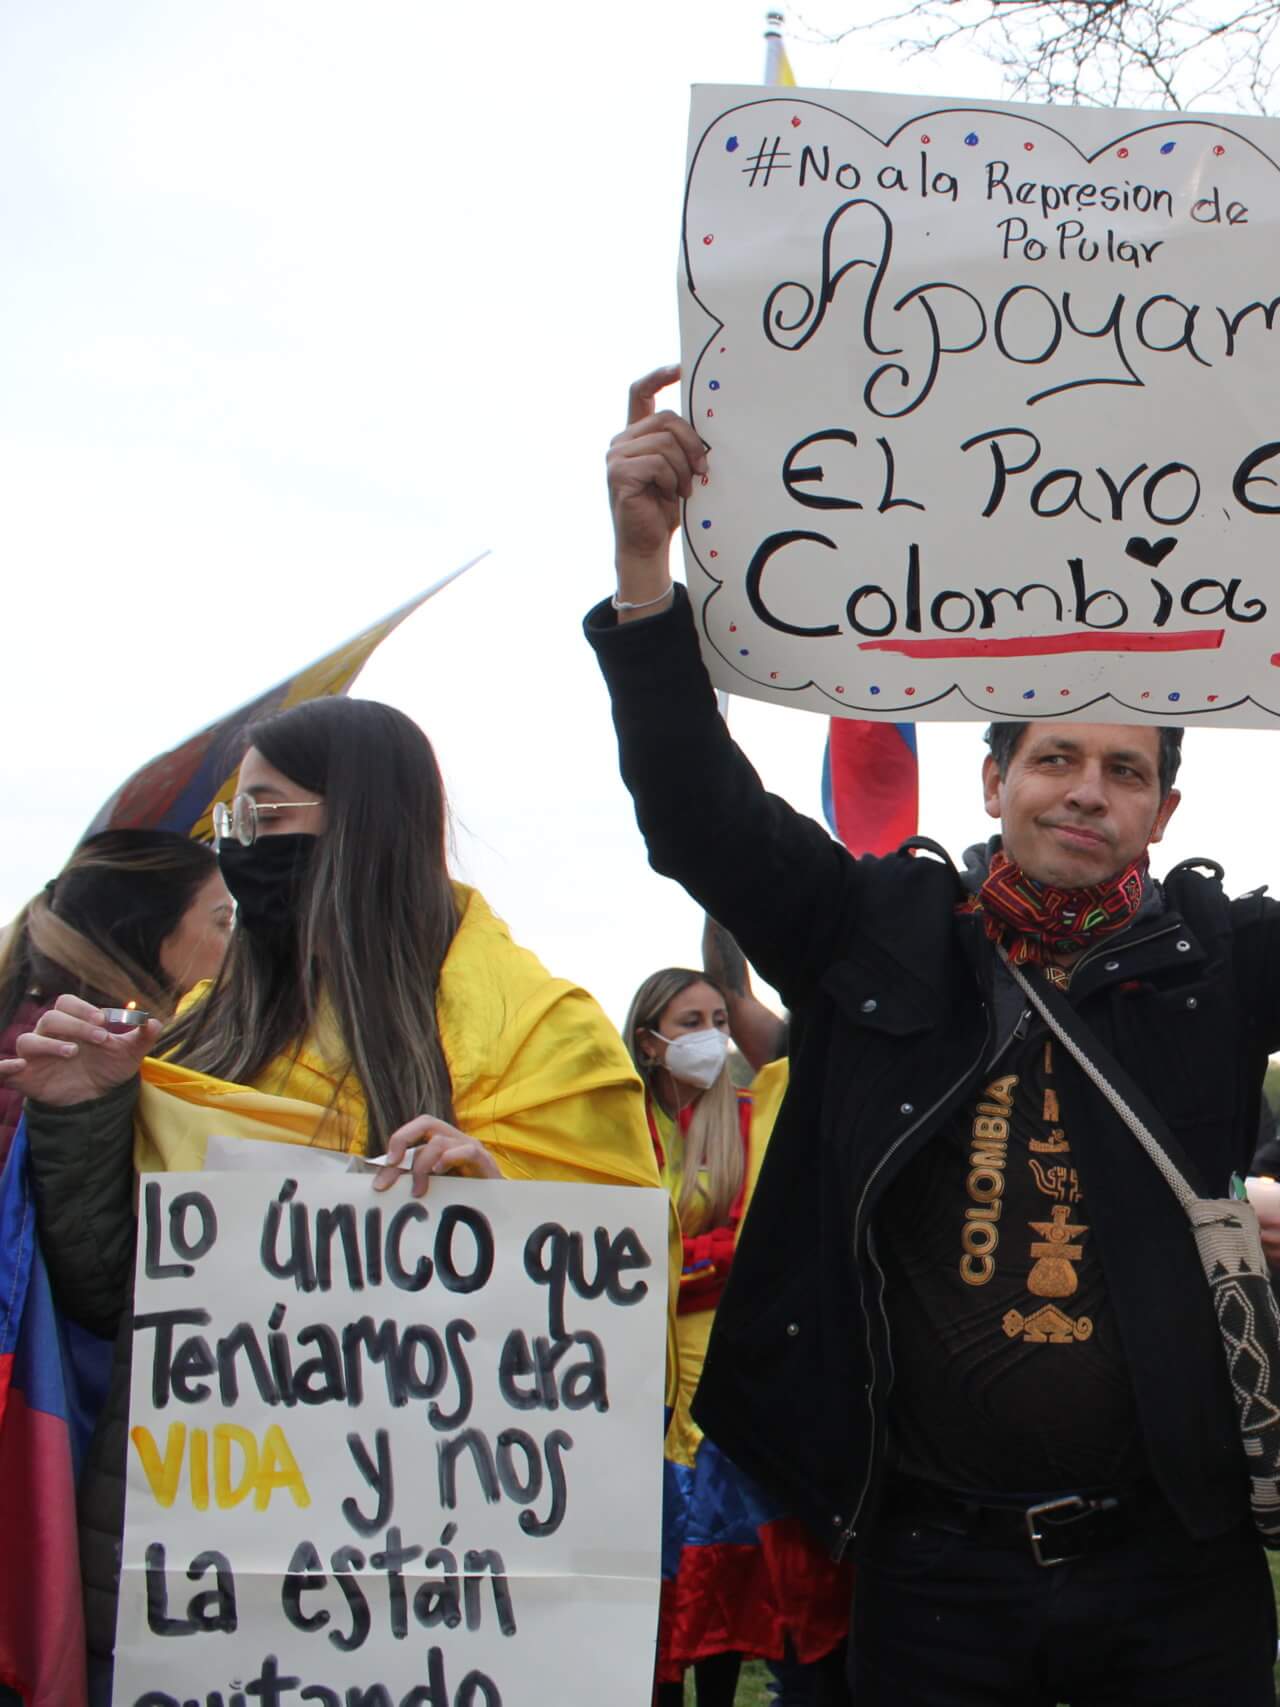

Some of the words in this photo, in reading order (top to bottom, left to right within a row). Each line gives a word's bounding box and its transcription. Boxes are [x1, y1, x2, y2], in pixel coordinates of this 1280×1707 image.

[921, 151, 958, 202] la
[985, 160, 1173, 219] Represion
[1189, 186, 1249, 225] de
[781, 429, 925, 513] EL
[960, 427, 1201, 524] Paro
[960, 1074, 1019, 1286] COLOMBIA
[523, 1222, 652, 1341] que
[132, 1302, 477, 1432] Teníamos
[499, 1328, 611, 1413] era
[131, 1421, 312, 1511] VIDA
[341, 1428, 395, 1538] y
[435, 1428, 573, 1537] nos
[144, 1541, 238, 1636] La
[282, 1521, 518, 1652] están
